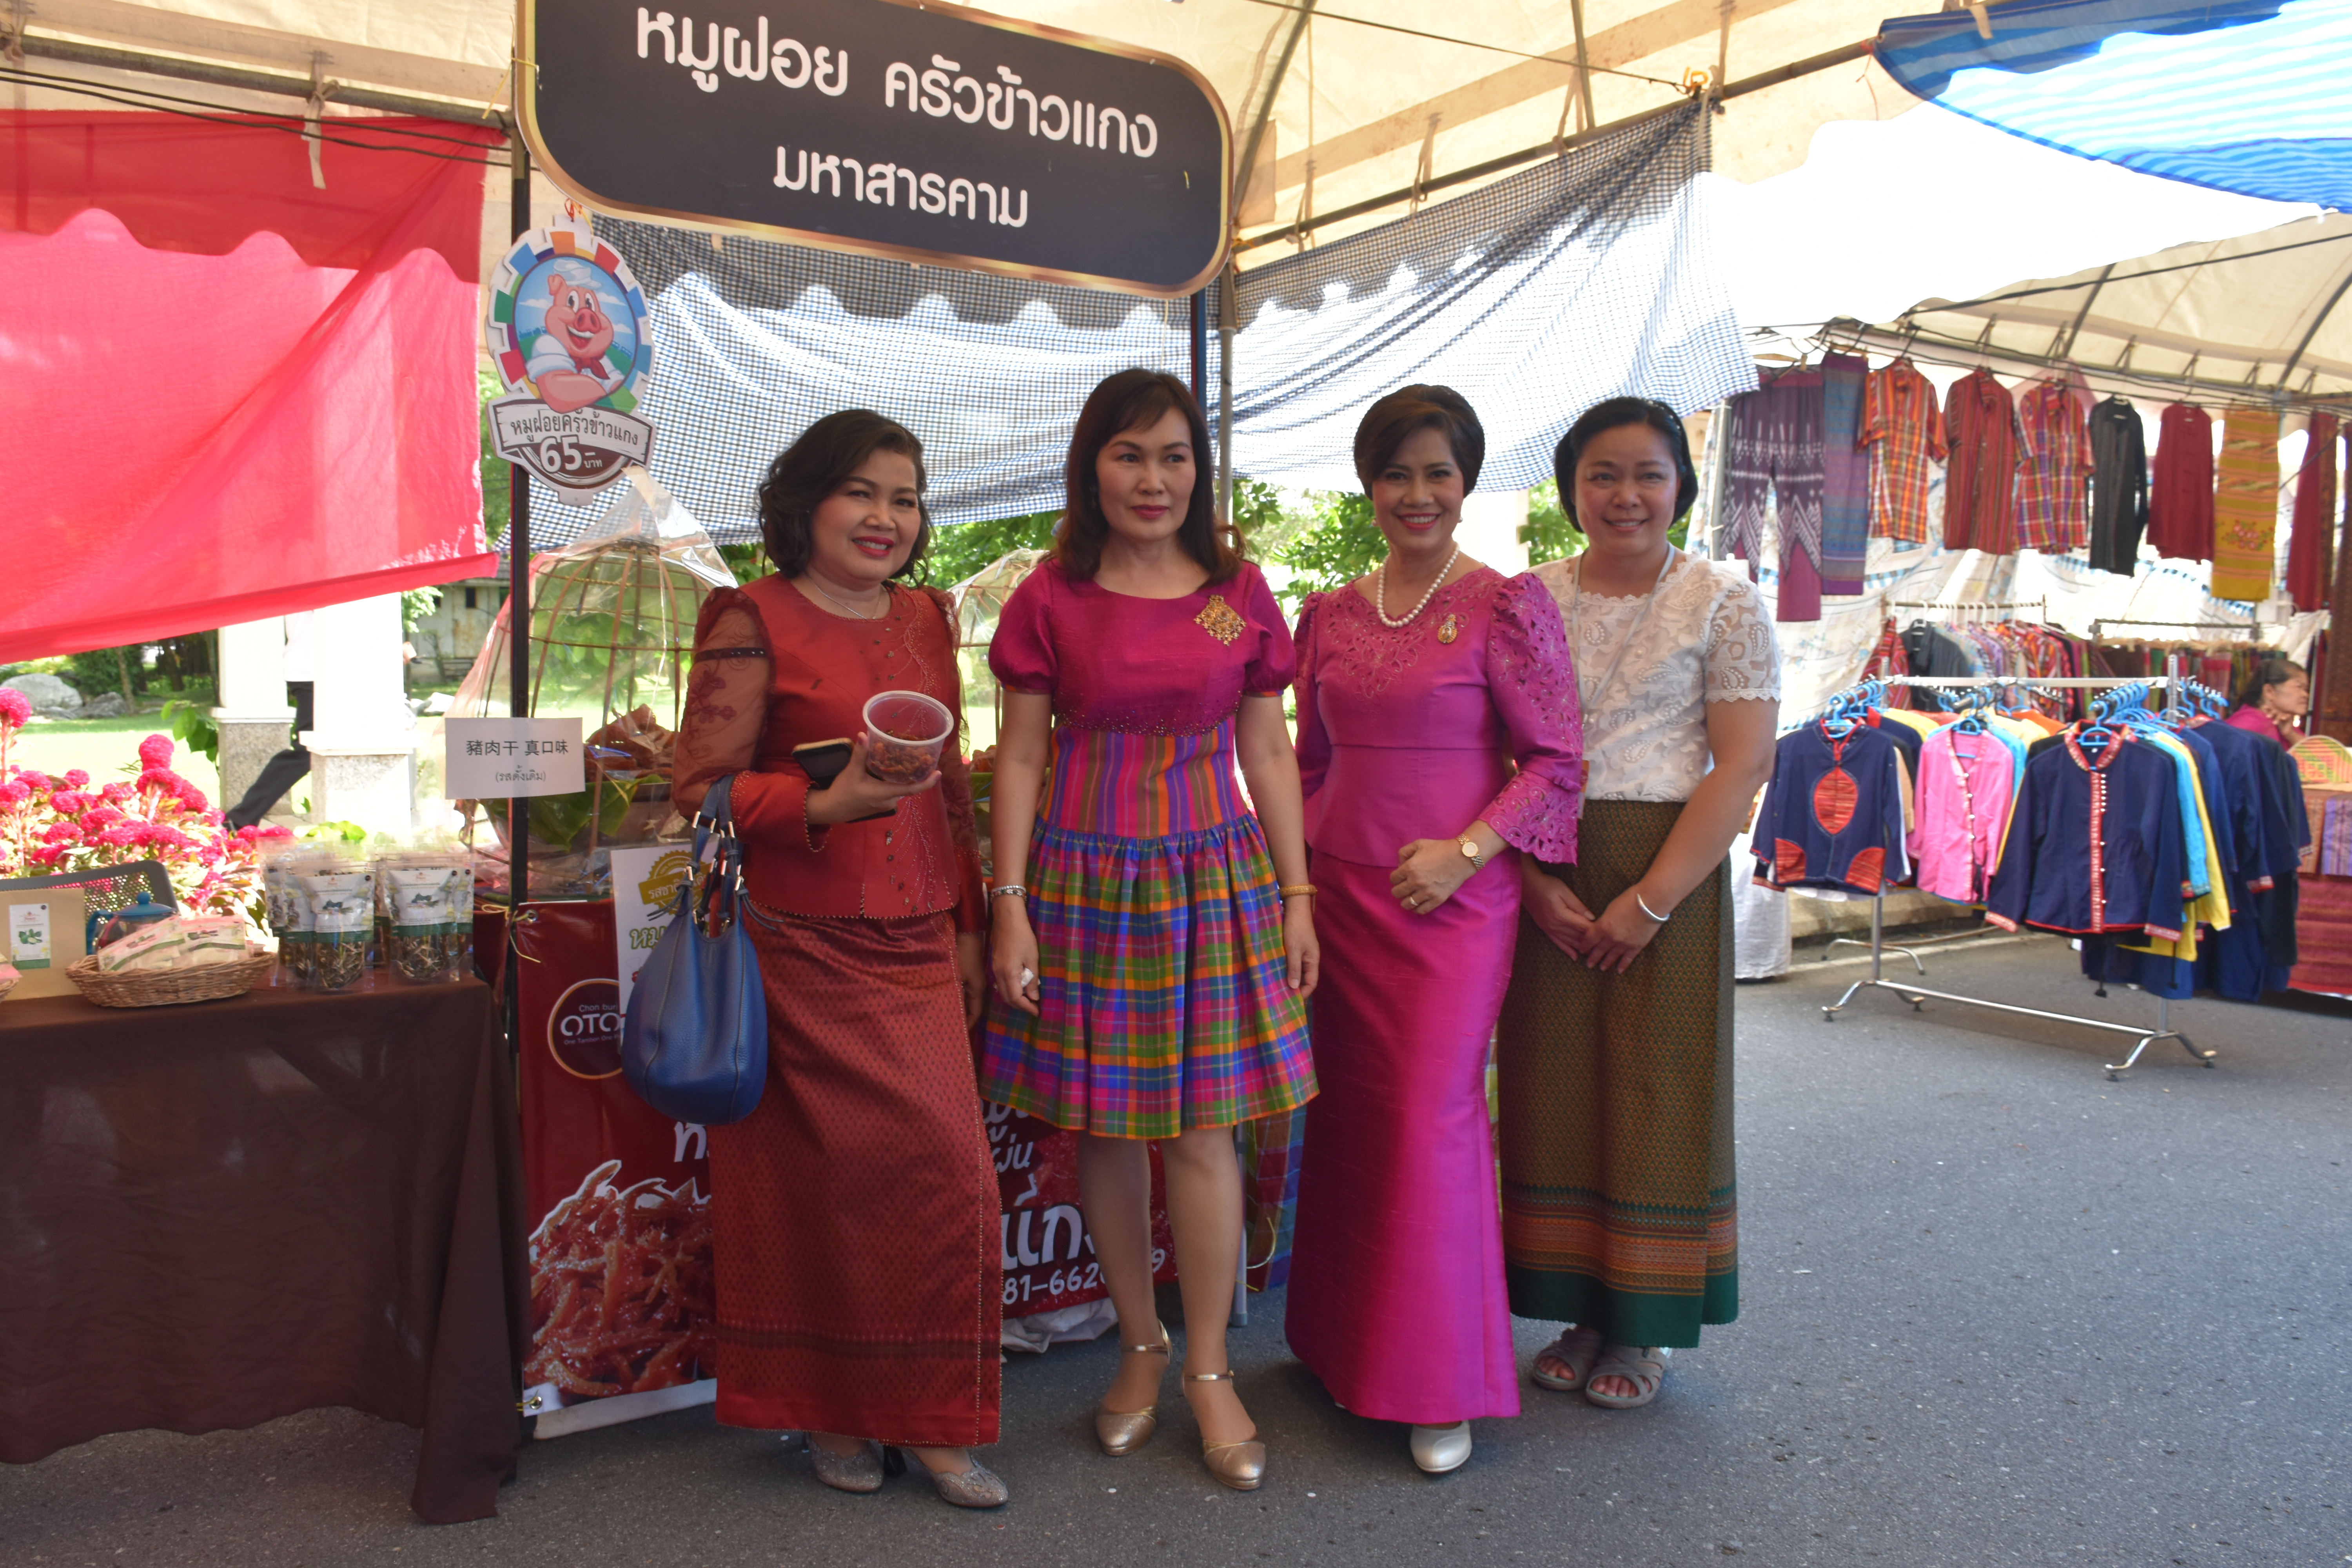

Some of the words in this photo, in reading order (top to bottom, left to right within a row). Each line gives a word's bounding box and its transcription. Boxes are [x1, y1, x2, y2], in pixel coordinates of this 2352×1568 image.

[637, 7, 848, 97] หมูฝอย
[885, 54, 1158, 158] ครัวข้าวแกง
[773, 146, 1028, 228] มหาสารคาม
[583, 459, 603, 468] บาท
[466, 740, 519, 756] 豬肉干
[524, 739, 568, 756] 真口味
[495, 765, 546, 782] (รสดั้งเดิม)
[561, 1012, 621, 1036] OTO
